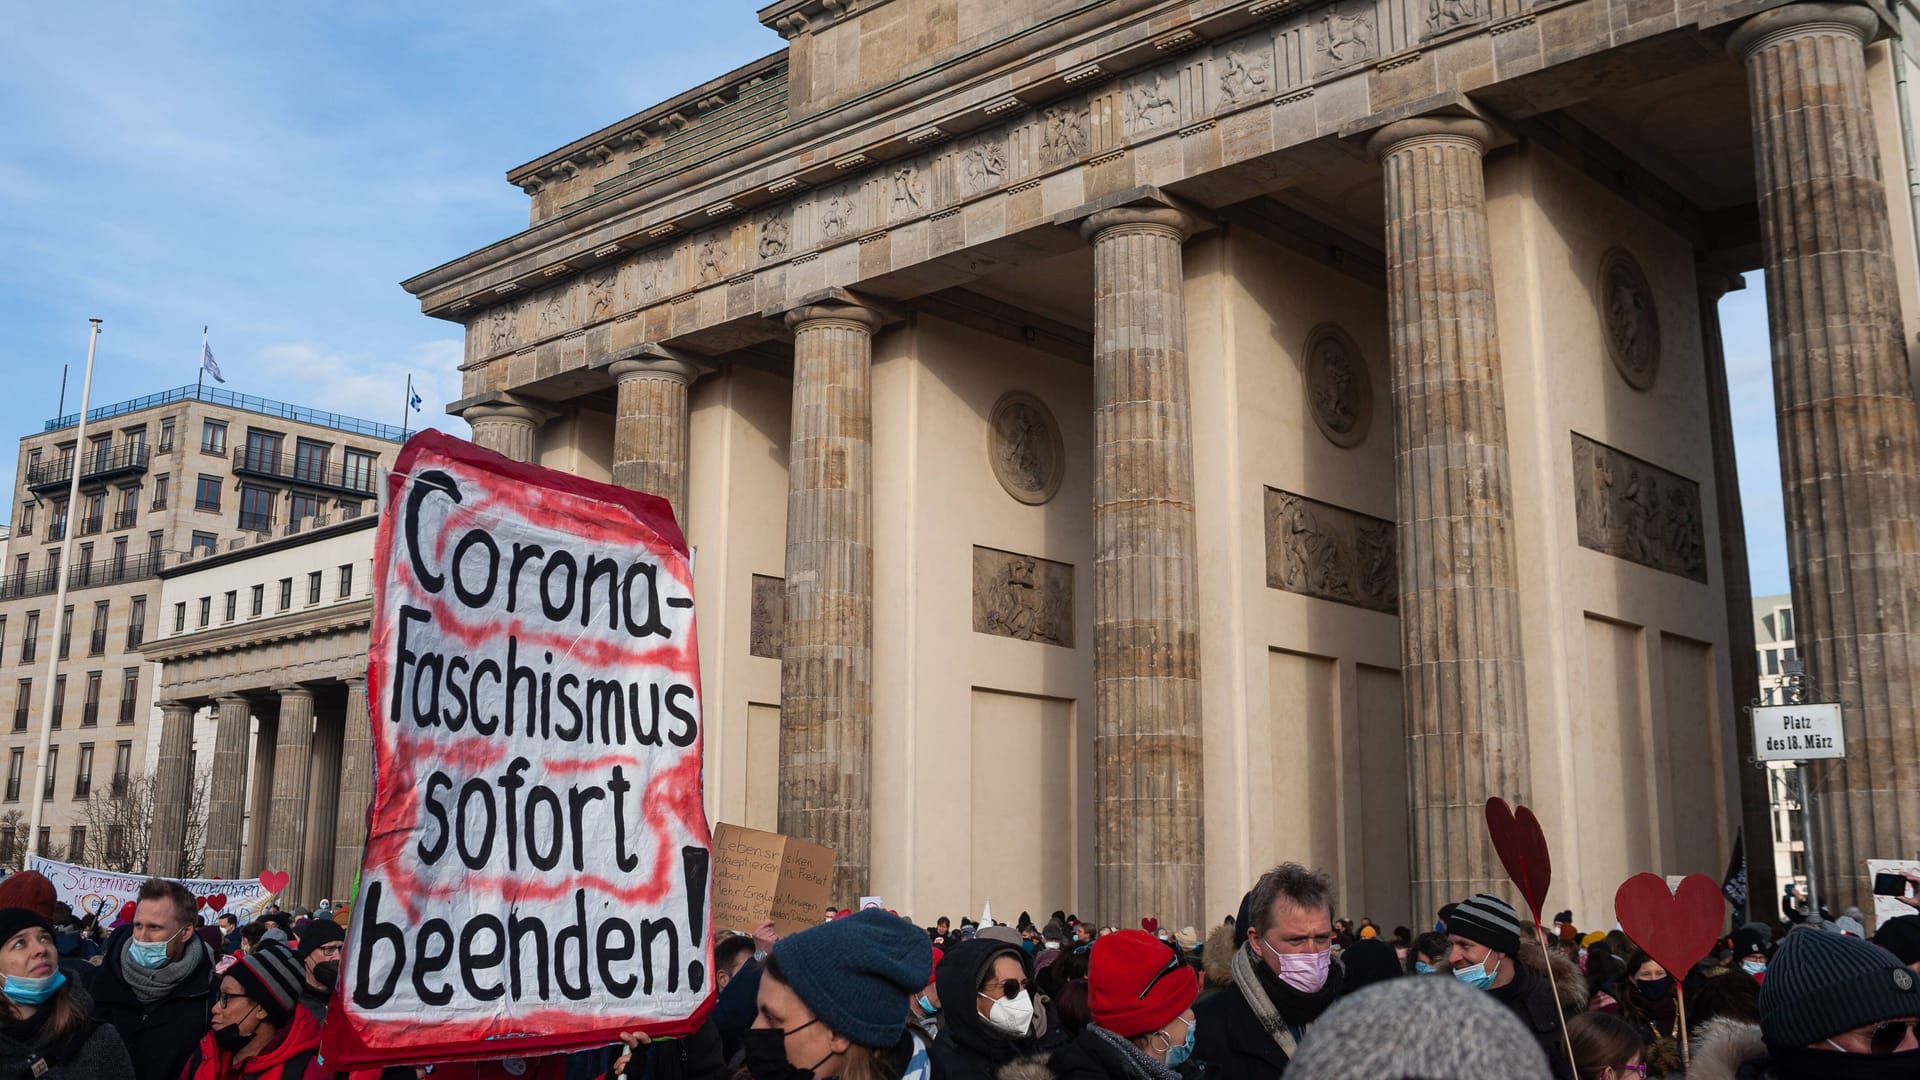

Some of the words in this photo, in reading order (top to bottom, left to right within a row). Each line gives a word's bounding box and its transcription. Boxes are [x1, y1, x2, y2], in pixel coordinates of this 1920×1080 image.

[406, 470, 694, 638] Corona-
[391, 605, 698, 747] Faschismus
[1783, 716, 1812, 730] Platz
[1766, 736, 1785, 751] des
[1788, 735, 1802, 750] 18.
[1804, 734, 1833, 749] März
[417, 757, 638, 873] sofort
[353, 845, 710, 1009] beenden!
